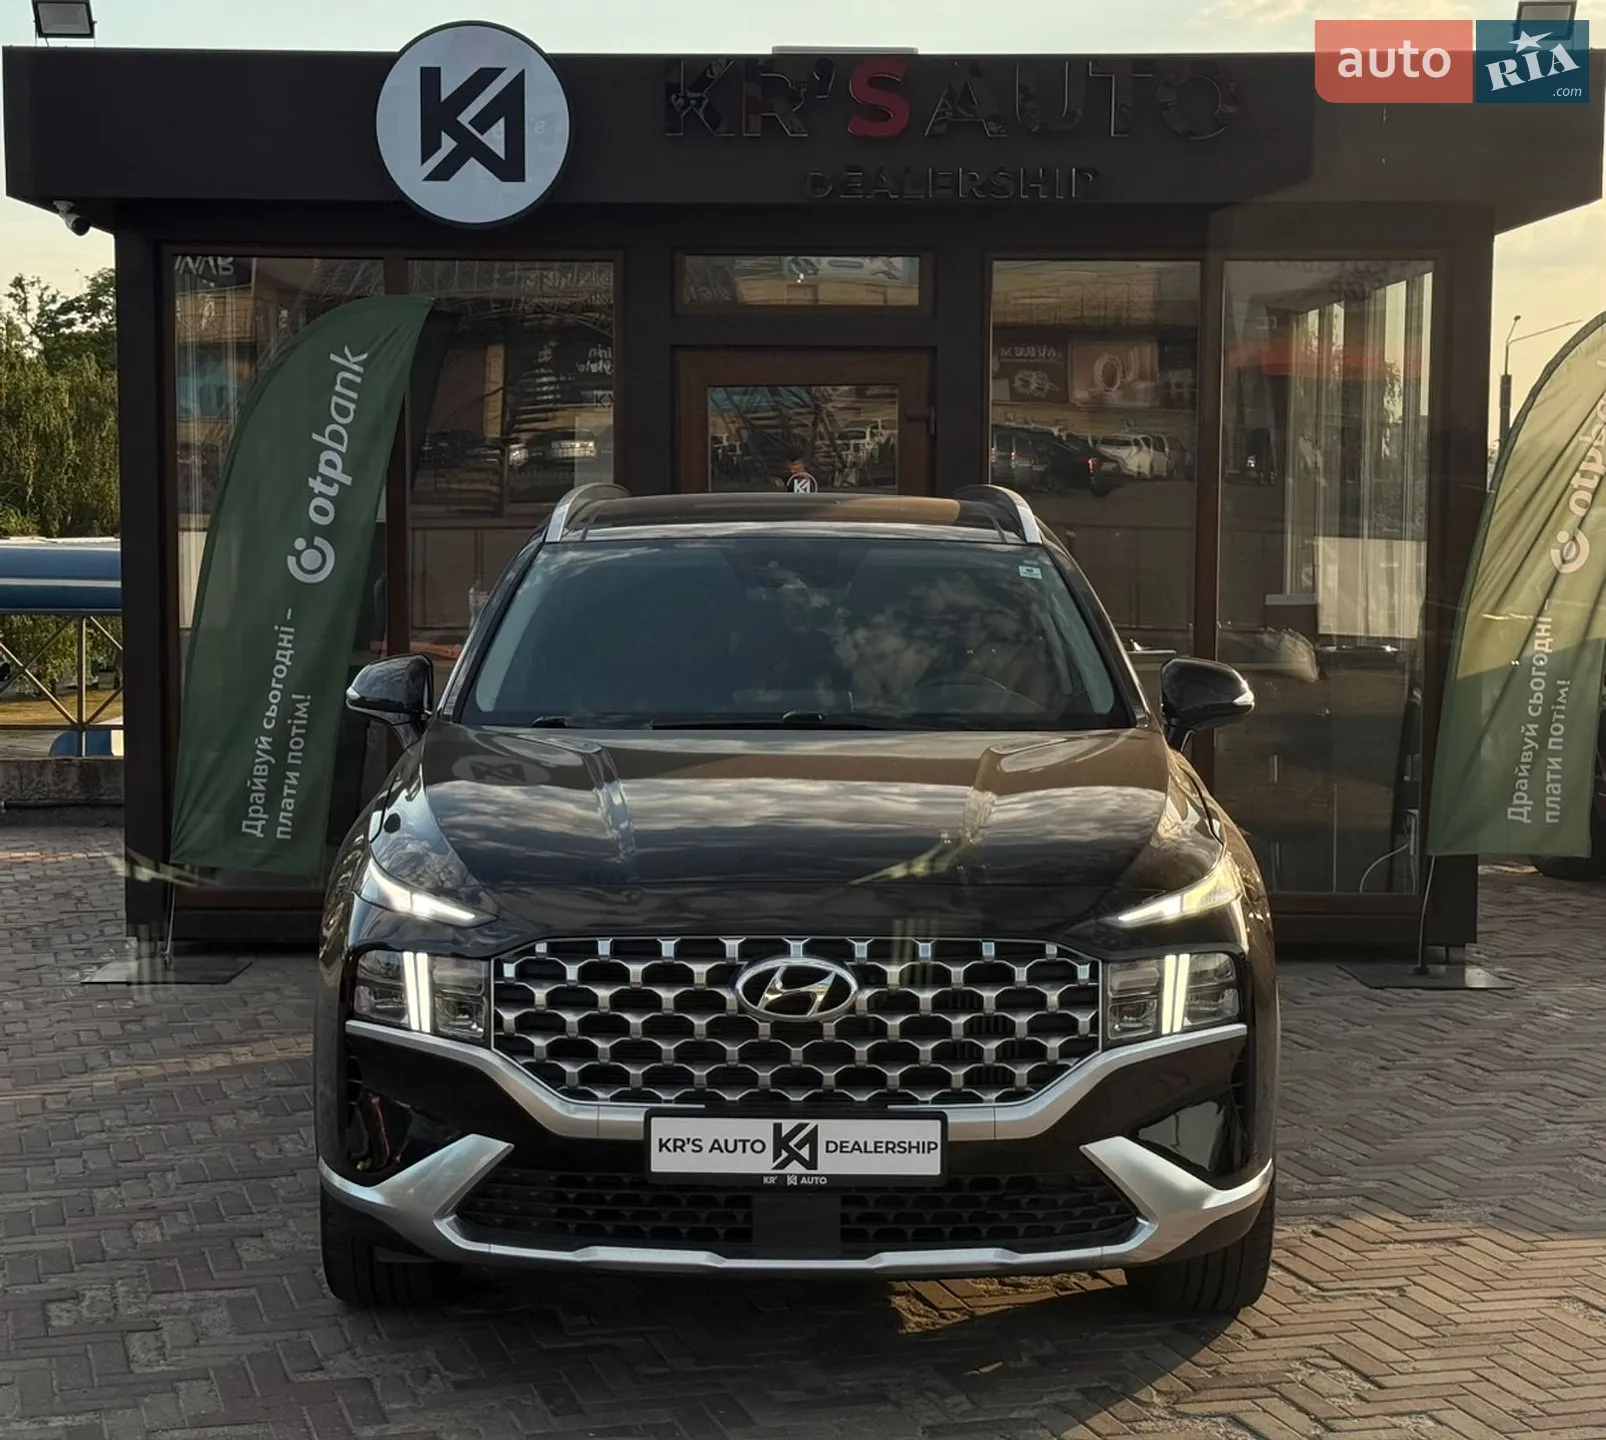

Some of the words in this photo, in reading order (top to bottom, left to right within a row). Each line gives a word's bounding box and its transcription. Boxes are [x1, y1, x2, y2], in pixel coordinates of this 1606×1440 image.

[803, 166, 1099, 200] DEALERSHIP
[308, 345, 368, 526] otpbank
[242, 737, 276, 838] Драйвуй
[263, 625, 296, 730] сьогодні
[287, 693, 311, 765] потім!
[1507, 726, 1540, 824] Драйвуй
[1528, 618, 1554, 717] сьогодні
[1548, 679, 1571, 751] потім!
[276, 771, 300, 840] плати
[1545, 758, 1563, 823] плати
[658, 1137, 703, 1154] KR'S
[708, 1138, 767, 1154] AUTO
[825, 1140, 939, 1154] DEALERSHIP
[800, 1176, 827, 1184] AUTO
